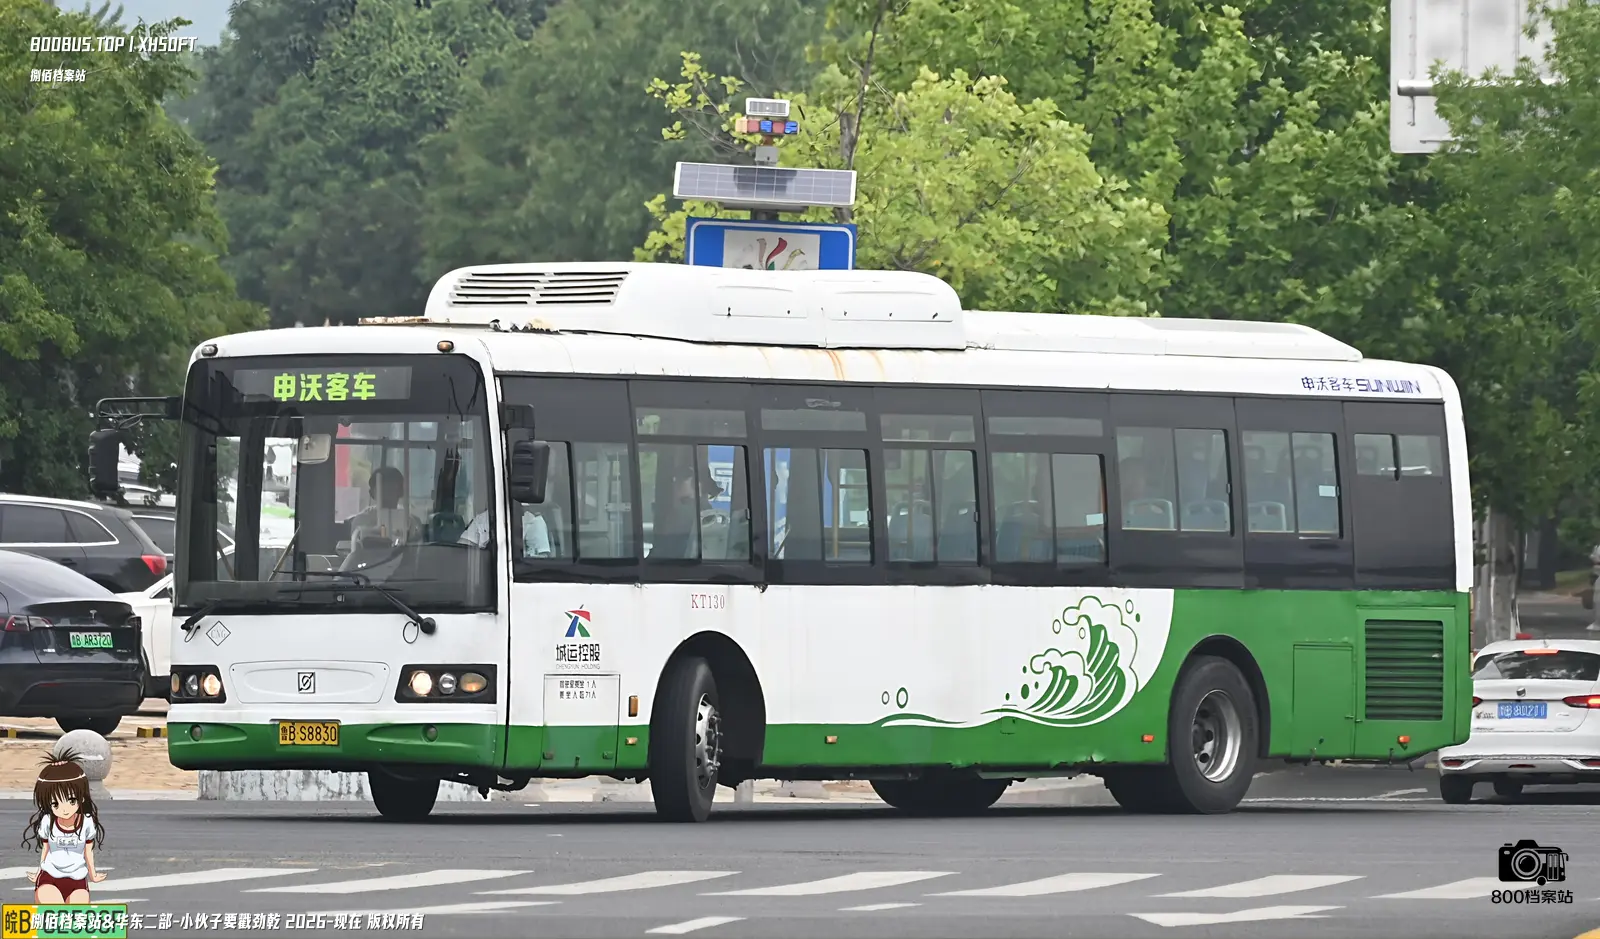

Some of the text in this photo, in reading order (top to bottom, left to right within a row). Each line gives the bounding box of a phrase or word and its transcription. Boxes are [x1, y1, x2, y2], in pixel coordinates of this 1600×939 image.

[273, 372, 377, 402] 申沃客车
[1301, 376, 1422, 394] 申沃客车 SUNWIN
[691, 594, 726, 610] KT130
[556, 643, 601, 662] 城运控股
